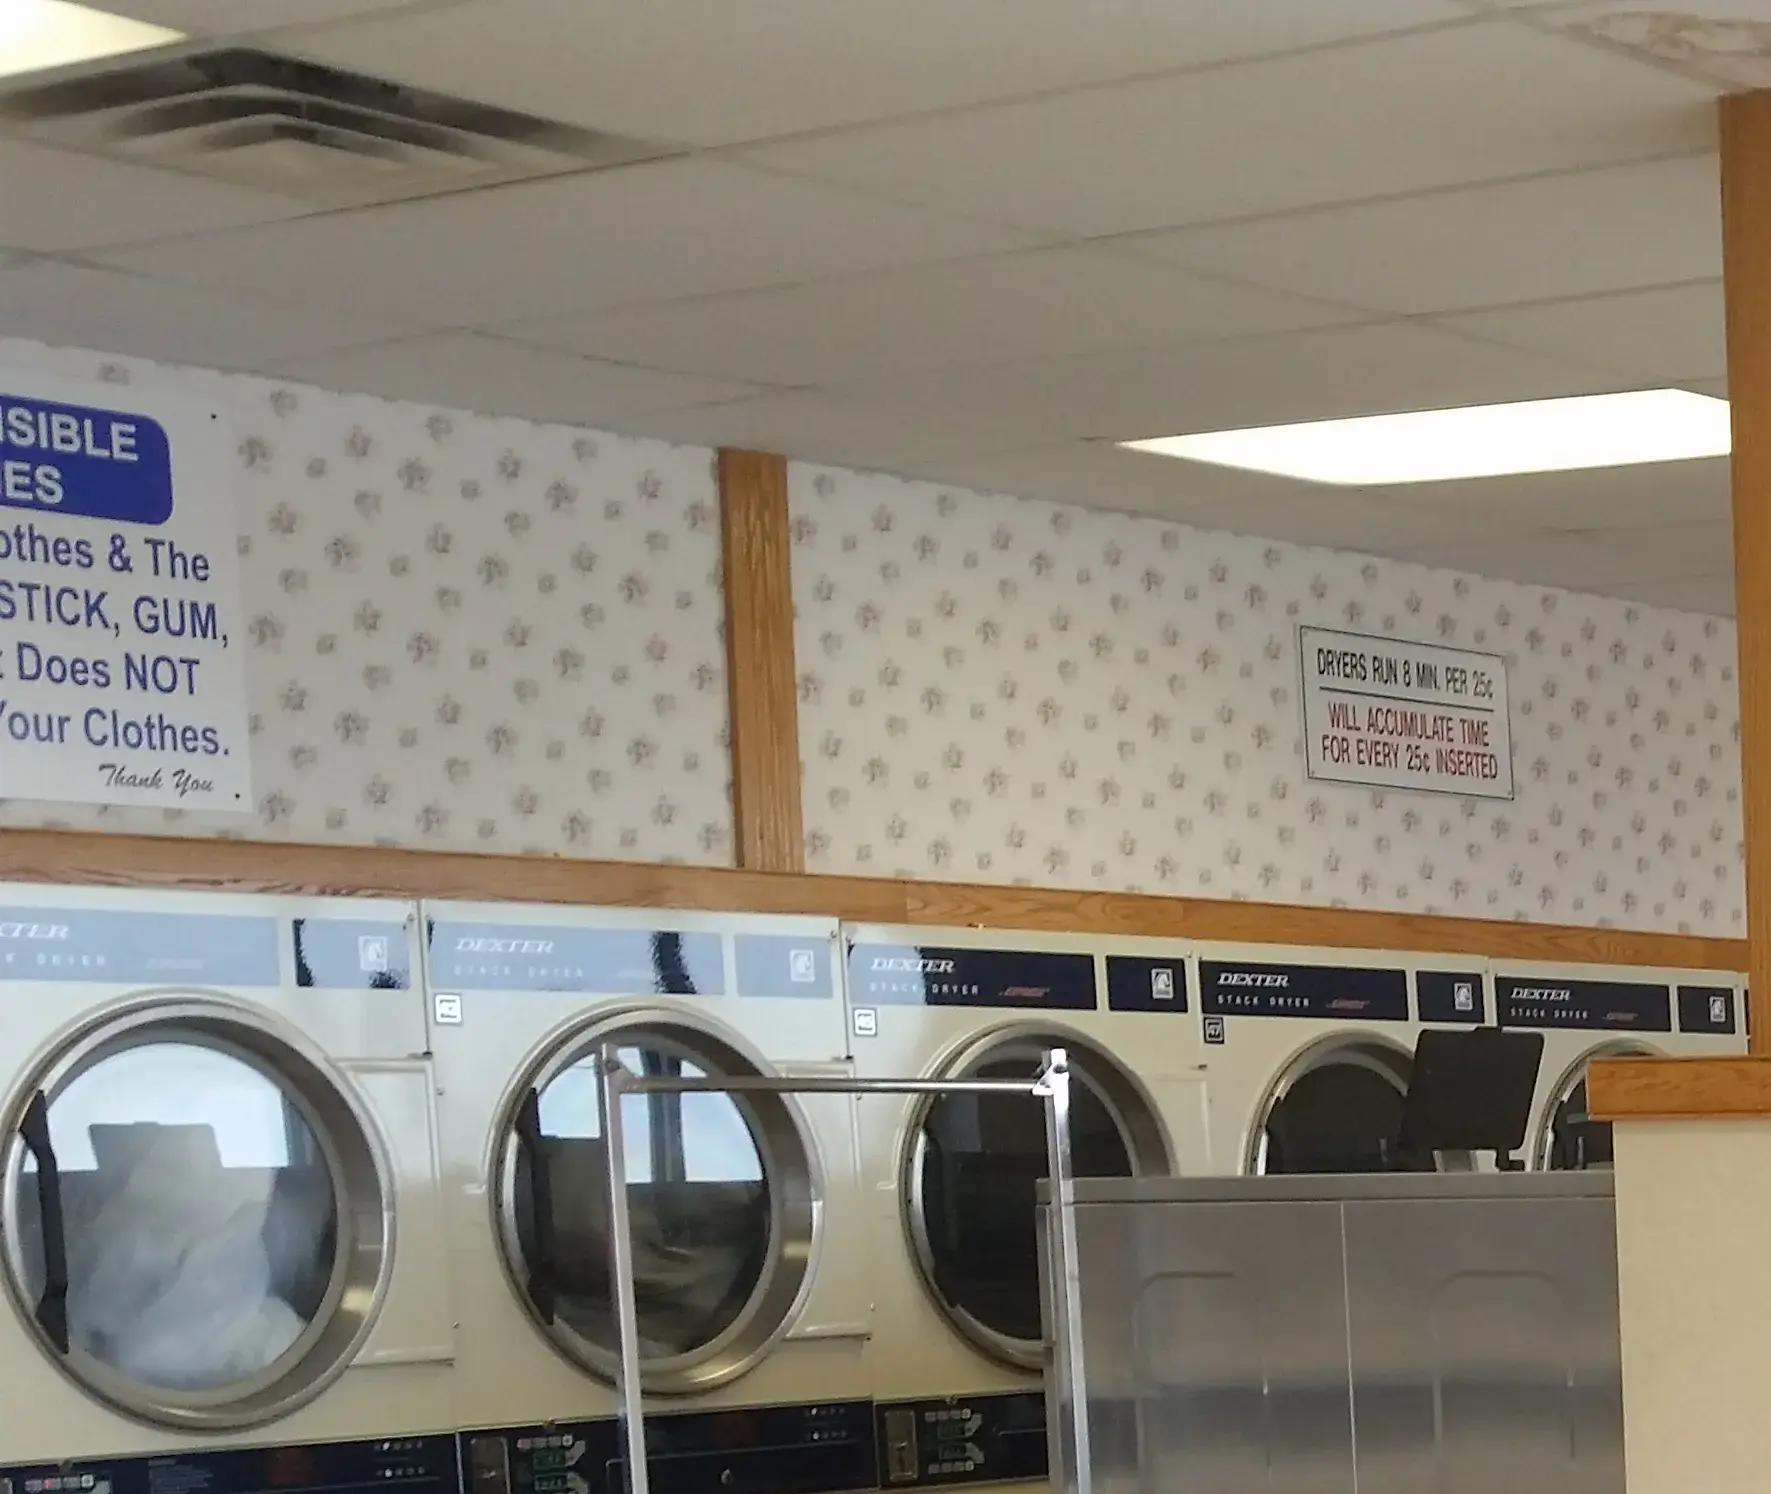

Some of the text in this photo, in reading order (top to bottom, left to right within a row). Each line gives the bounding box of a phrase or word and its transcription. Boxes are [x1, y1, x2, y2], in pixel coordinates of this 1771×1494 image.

[0, 404, 139, 462] SIBLE
[108, 533, 133, 573] &
[144, 536, 211, 582] The
[0, 579, 229, 648] STICK, GUM,
[17, 641, 111, 688] Does
[124, 652, 200, 695] NOT
[1317, 648, 1367, 682] DRYERS
[1373, 656, 1398, 685] RUN
[1403, 660, 1411, 687] 8
[1416, 662, 1441, 690] MIN.
[1445, 667, 1468, 695] PER
[84, 707, 229, 756] Clothes.
[1328, 701, 1490, 747] WILL ACCUMULATE TIME
[1321, 734, 1350, 763] FOR
[1356, 739, 1400, 768] EVERY
[1436, 749, 1498, 779] INSERTED
[98, 763, 214, 798] Thank You
[456, 938, 555, 954] DEXTER
[871, 958, 956, 973] DEXTER
[1217, 972, 1289, 988] DEXTER
[1510, 987, 1571, 1001] DEXTER
